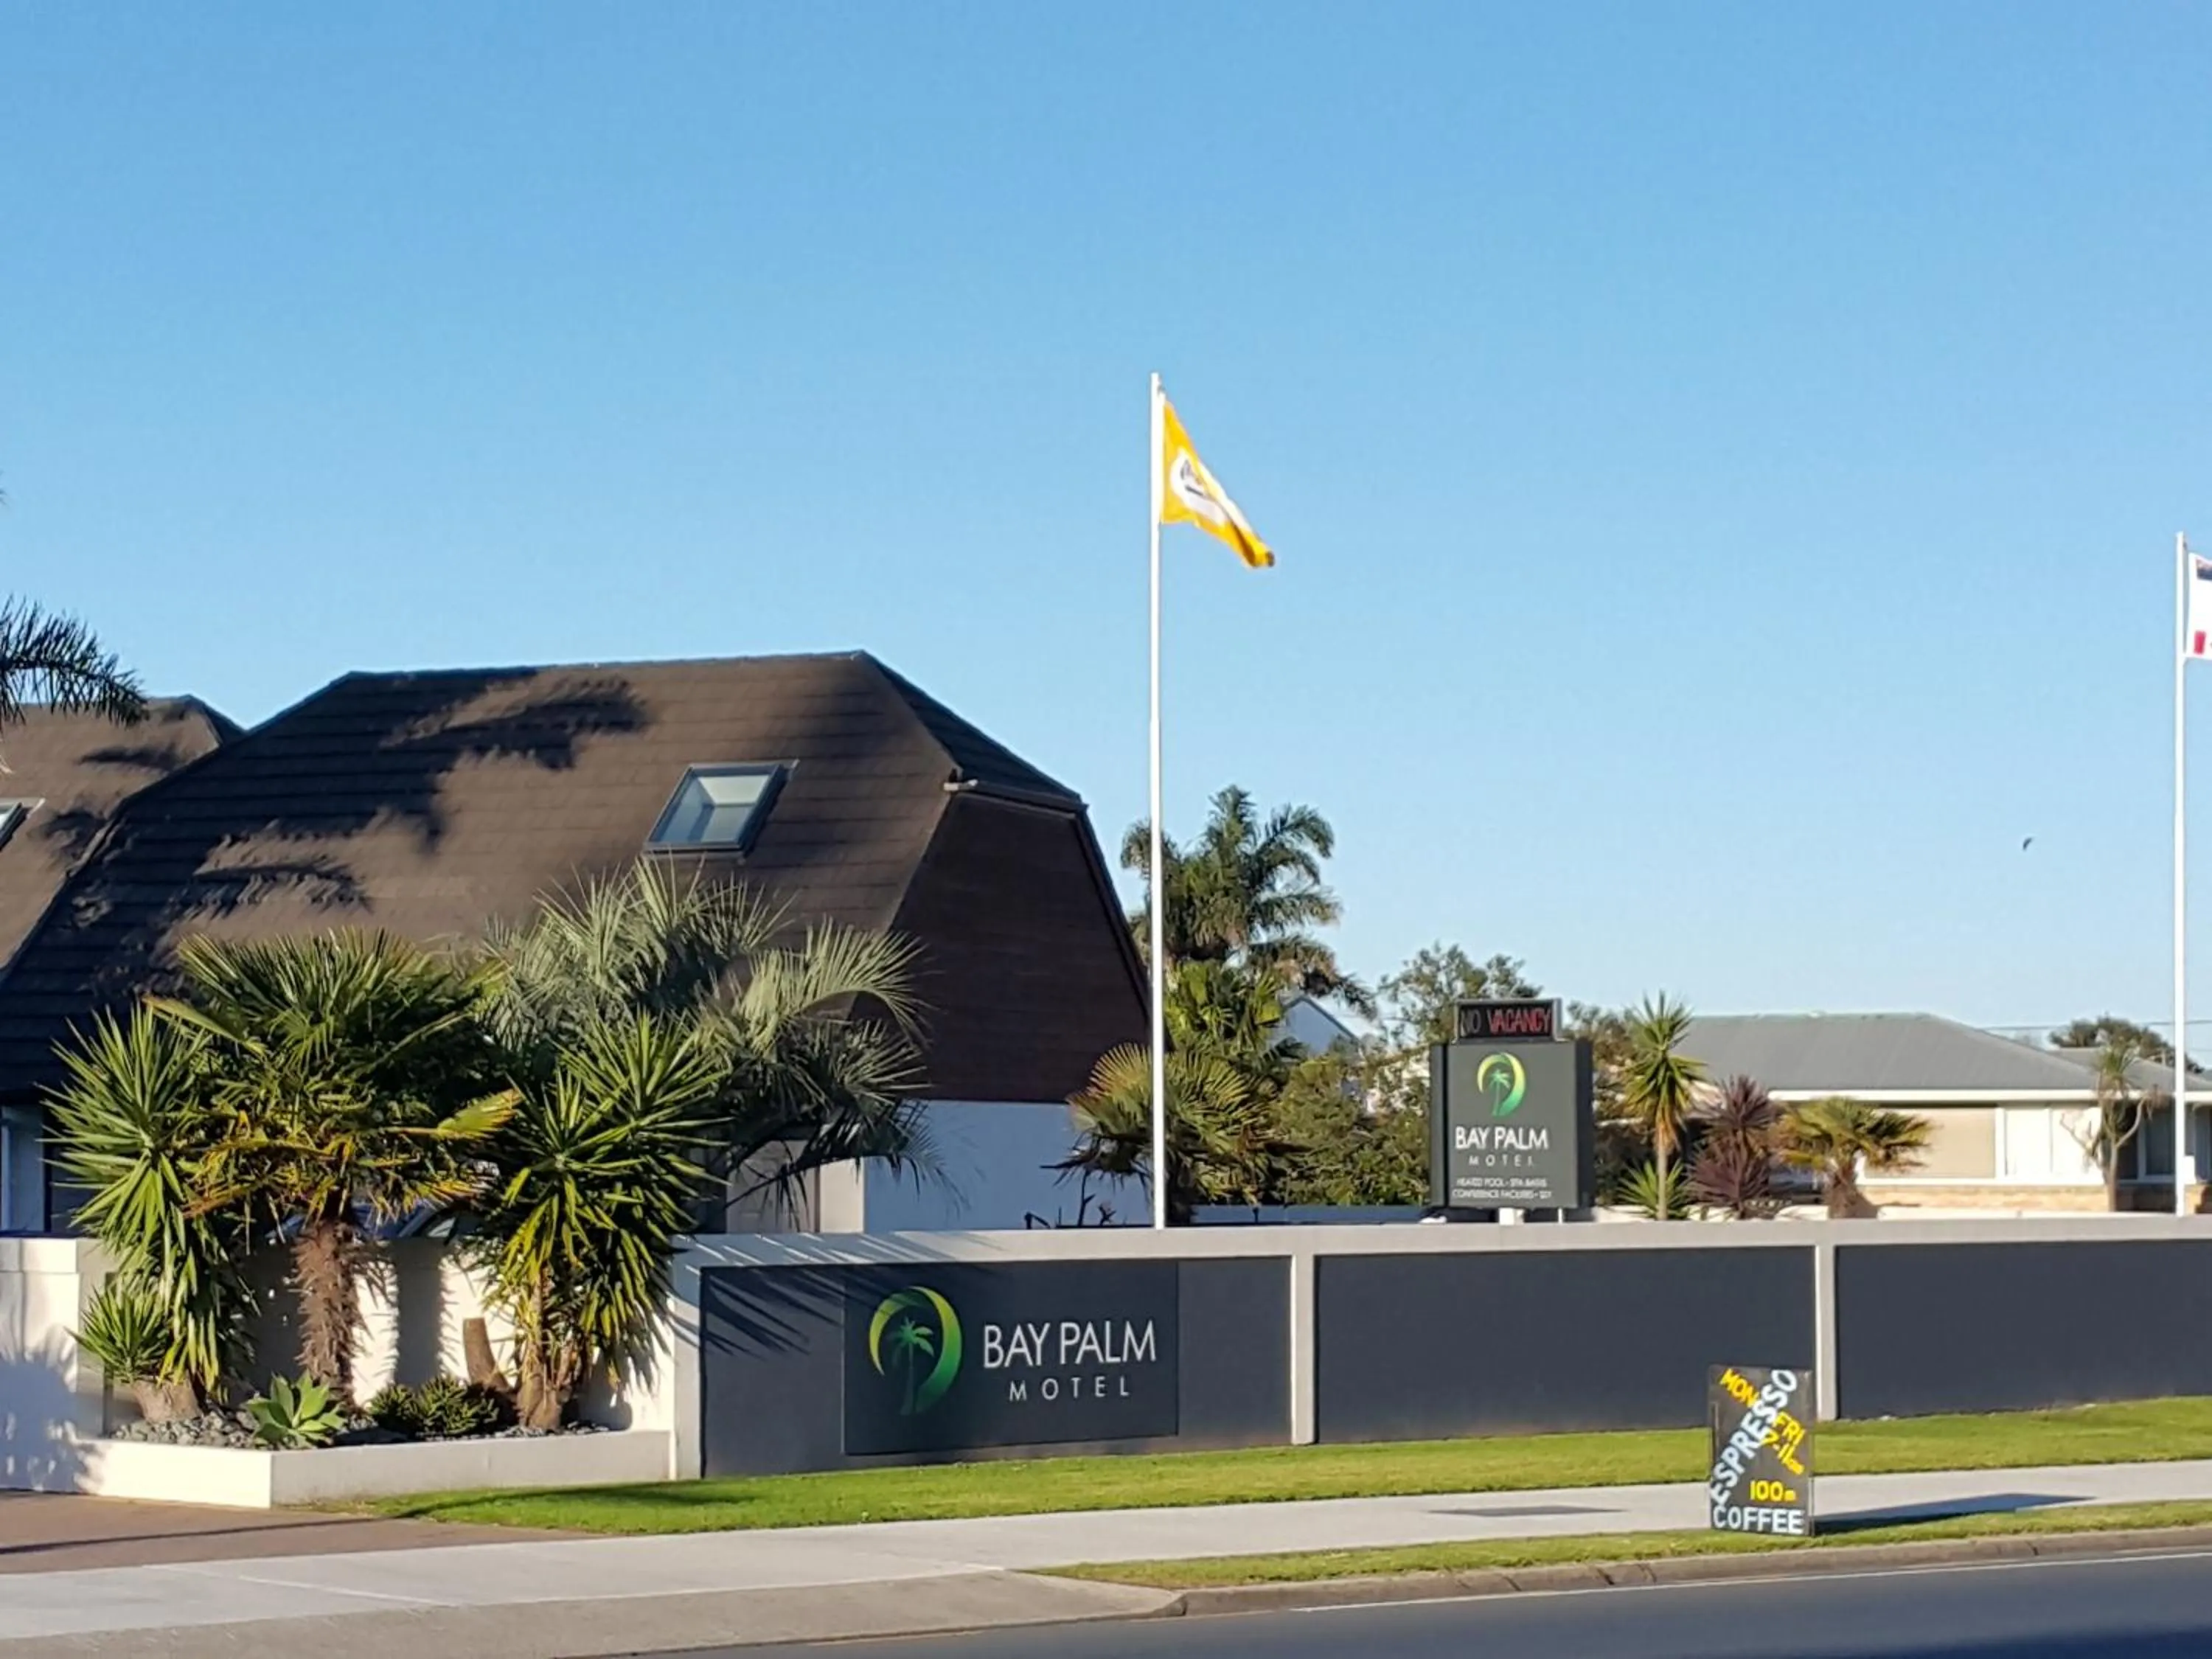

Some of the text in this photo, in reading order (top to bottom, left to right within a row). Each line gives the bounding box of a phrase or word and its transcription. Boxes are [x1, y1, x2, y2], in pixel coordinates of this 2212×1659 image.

[1461, 1007, 1551, 1035] NO VACANCY
[1455, 1126, 1548, 1150] BAY PALM
[1469, 1155, 1534, 1167] MOTEL
[983, 1320, 1156, 1368] BAY PALM
[1009, 1376, 1130, 1401] MOTEL
[1719, 1368, 1806, 1446] MON FRI
[1710, 1369, 1797, 1505] ESPRESSO
[1713, 1506, 1804, 1534] COFFEE
